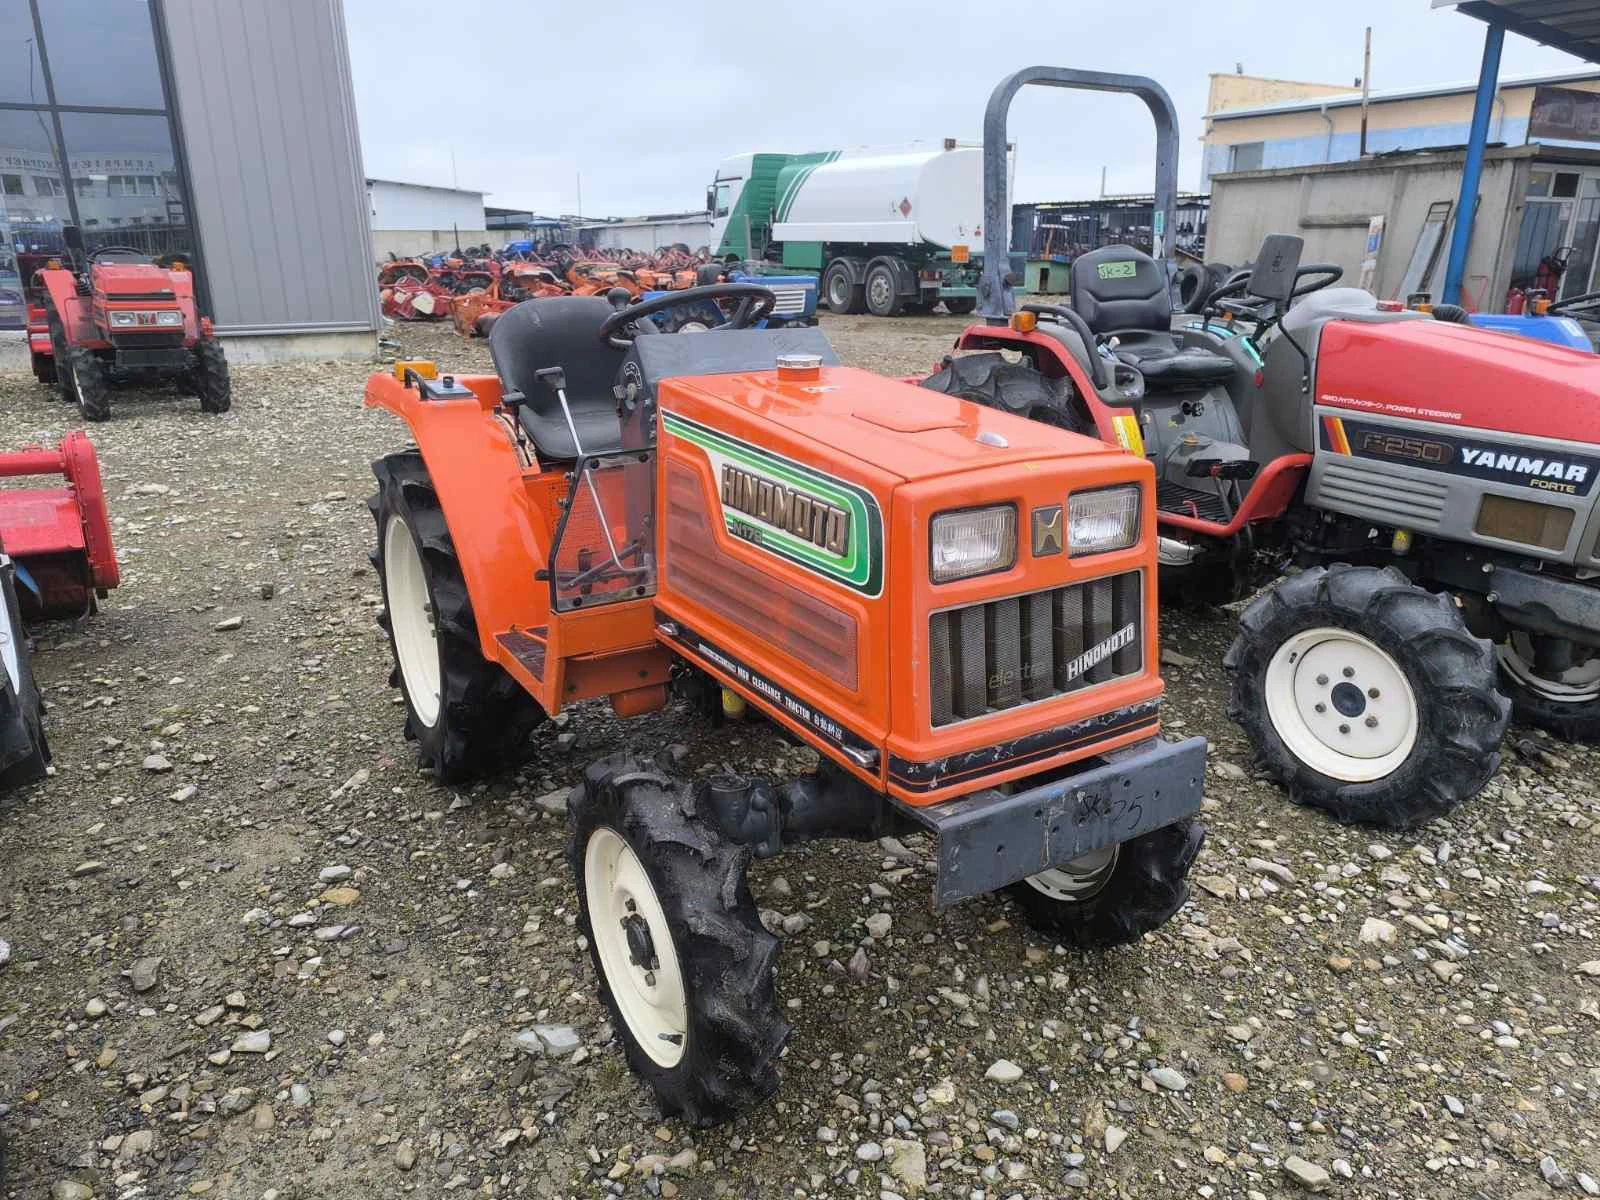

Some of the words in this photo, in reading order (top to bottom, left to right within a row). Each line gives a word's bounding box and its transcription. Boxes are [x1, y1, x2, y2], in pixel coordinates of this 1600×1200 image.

[1461, 447, 1588, 483] YANMAR
[1530, 478, 1576, 494] FORTE
[721, 464, 848, 558] HINOMOTO
[1066, 623, 1136, 682] HINOMOTO
[751, 674, 782, 704] CLEARANCE
[785, 696, 811, 721] TRACTOR
